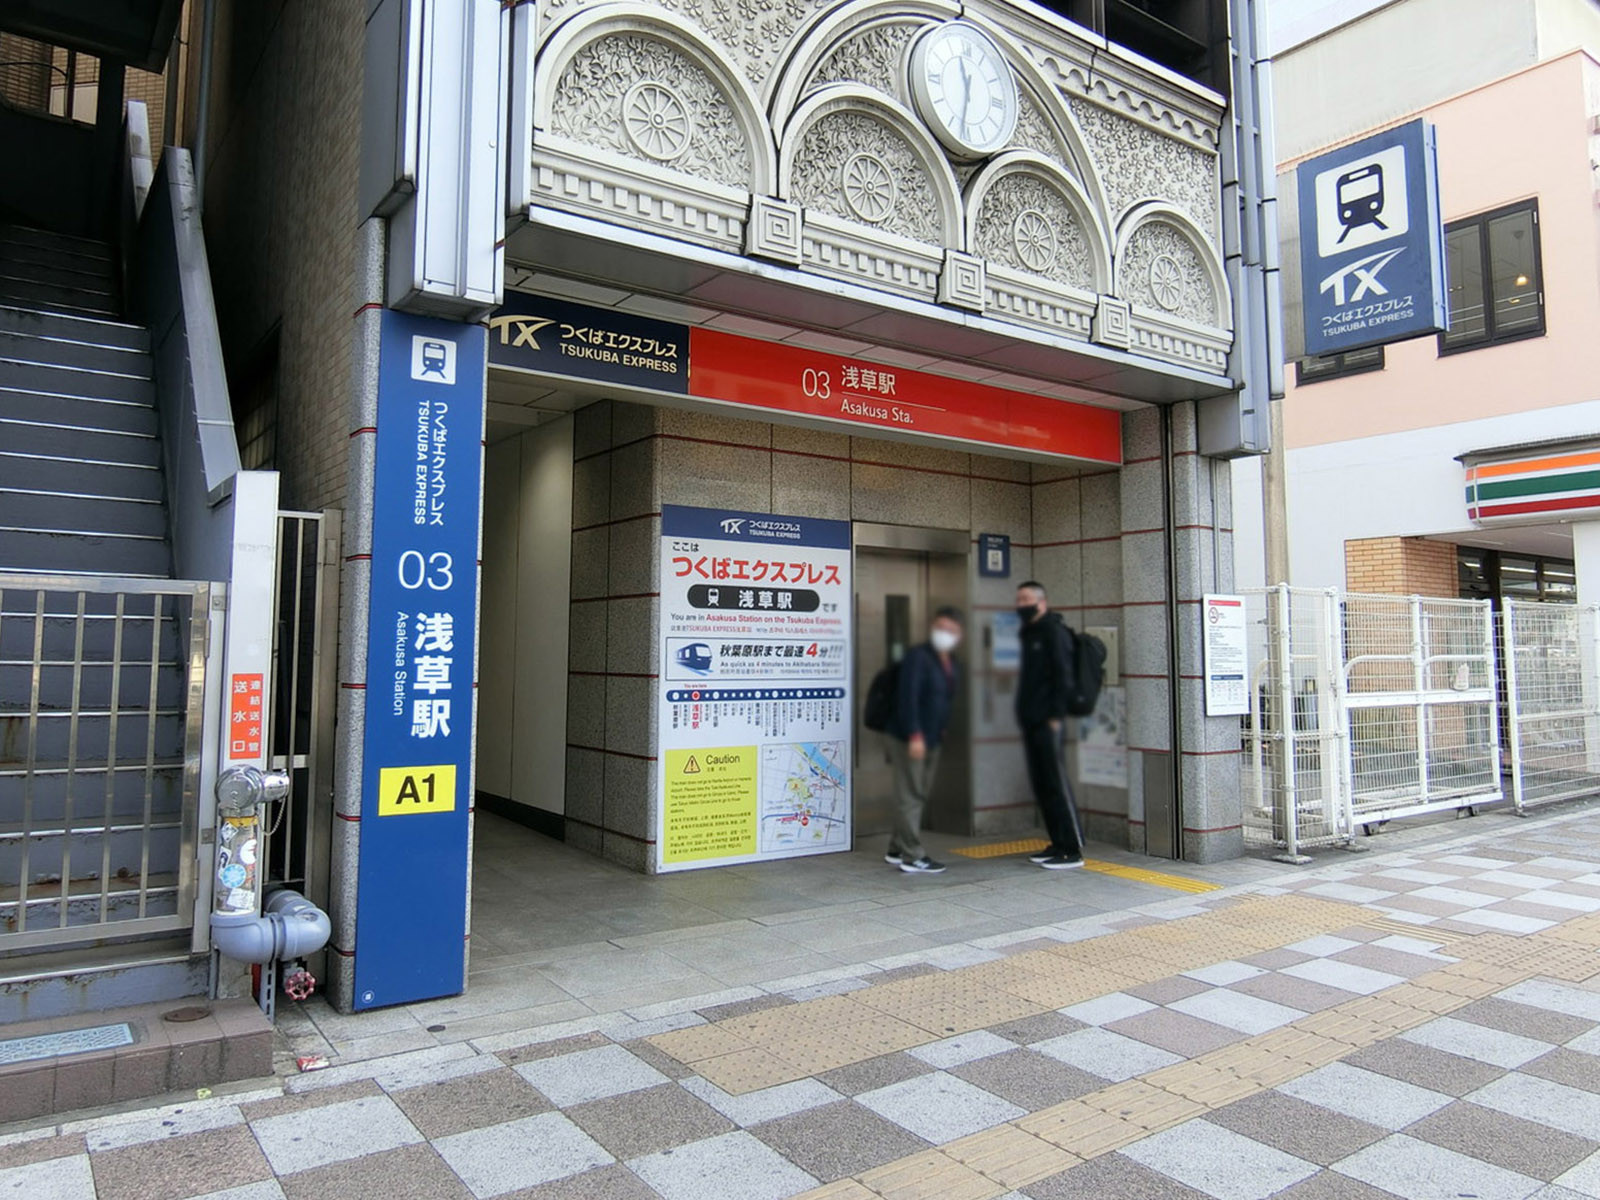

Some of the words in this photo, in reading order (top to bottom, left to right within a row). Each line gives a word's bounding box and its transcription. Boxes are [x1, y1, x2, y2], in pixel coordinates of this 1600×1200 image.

[1320, 246, 1407, 306] TX
[1321, 295, 1414, 327] つくばエクスプレス
[1322, 321, 1367, 337] TSUKUBA
[1368, 309, 1414, 327] EXPRESS
[490, 315, 556, 350] TX
[559, 323, 678, 358] つくばエクスプレス
[559, 342, 619, 364] TSUKUBA
[622, 354, 678, 374] EXPRESS
[802, 368, 831, 399] 03
[840, 365, 896, 395] 浅草駅
[840, 398, 888, 420] Asakusa
[891, 406, 914, 424] Sta.
[416, 400, 430, 461] TSUKUBA
[429, 401, 449, 526] つくばエクスプレス
[414, 463, 428, 525] EXPRESS
[719, 517, 747, 535] TX
[672, 541, 699, 552] ここは
[397, 550, 454, 591] 03
[672, 556, 841, 585] つくばエクスプレス
[738, 589, 792, 609] 浅草駅
[671, 613, 684, 621] You
[698, 613, 705, 621] in
[706, 613, 737, 622] Asakusa
[738, 614, 763, 623] Station
[774, 615, 785, 623] the
[395, 610, 410, 668] Asakusa
[410, 611, 455, 739] 浅草駅
[393, 669, 408, 717] Station
[232, 680, 248, 752] 送水口
[705, 754, 741, 766] Caution
[394, 772, 436, 806] A1
